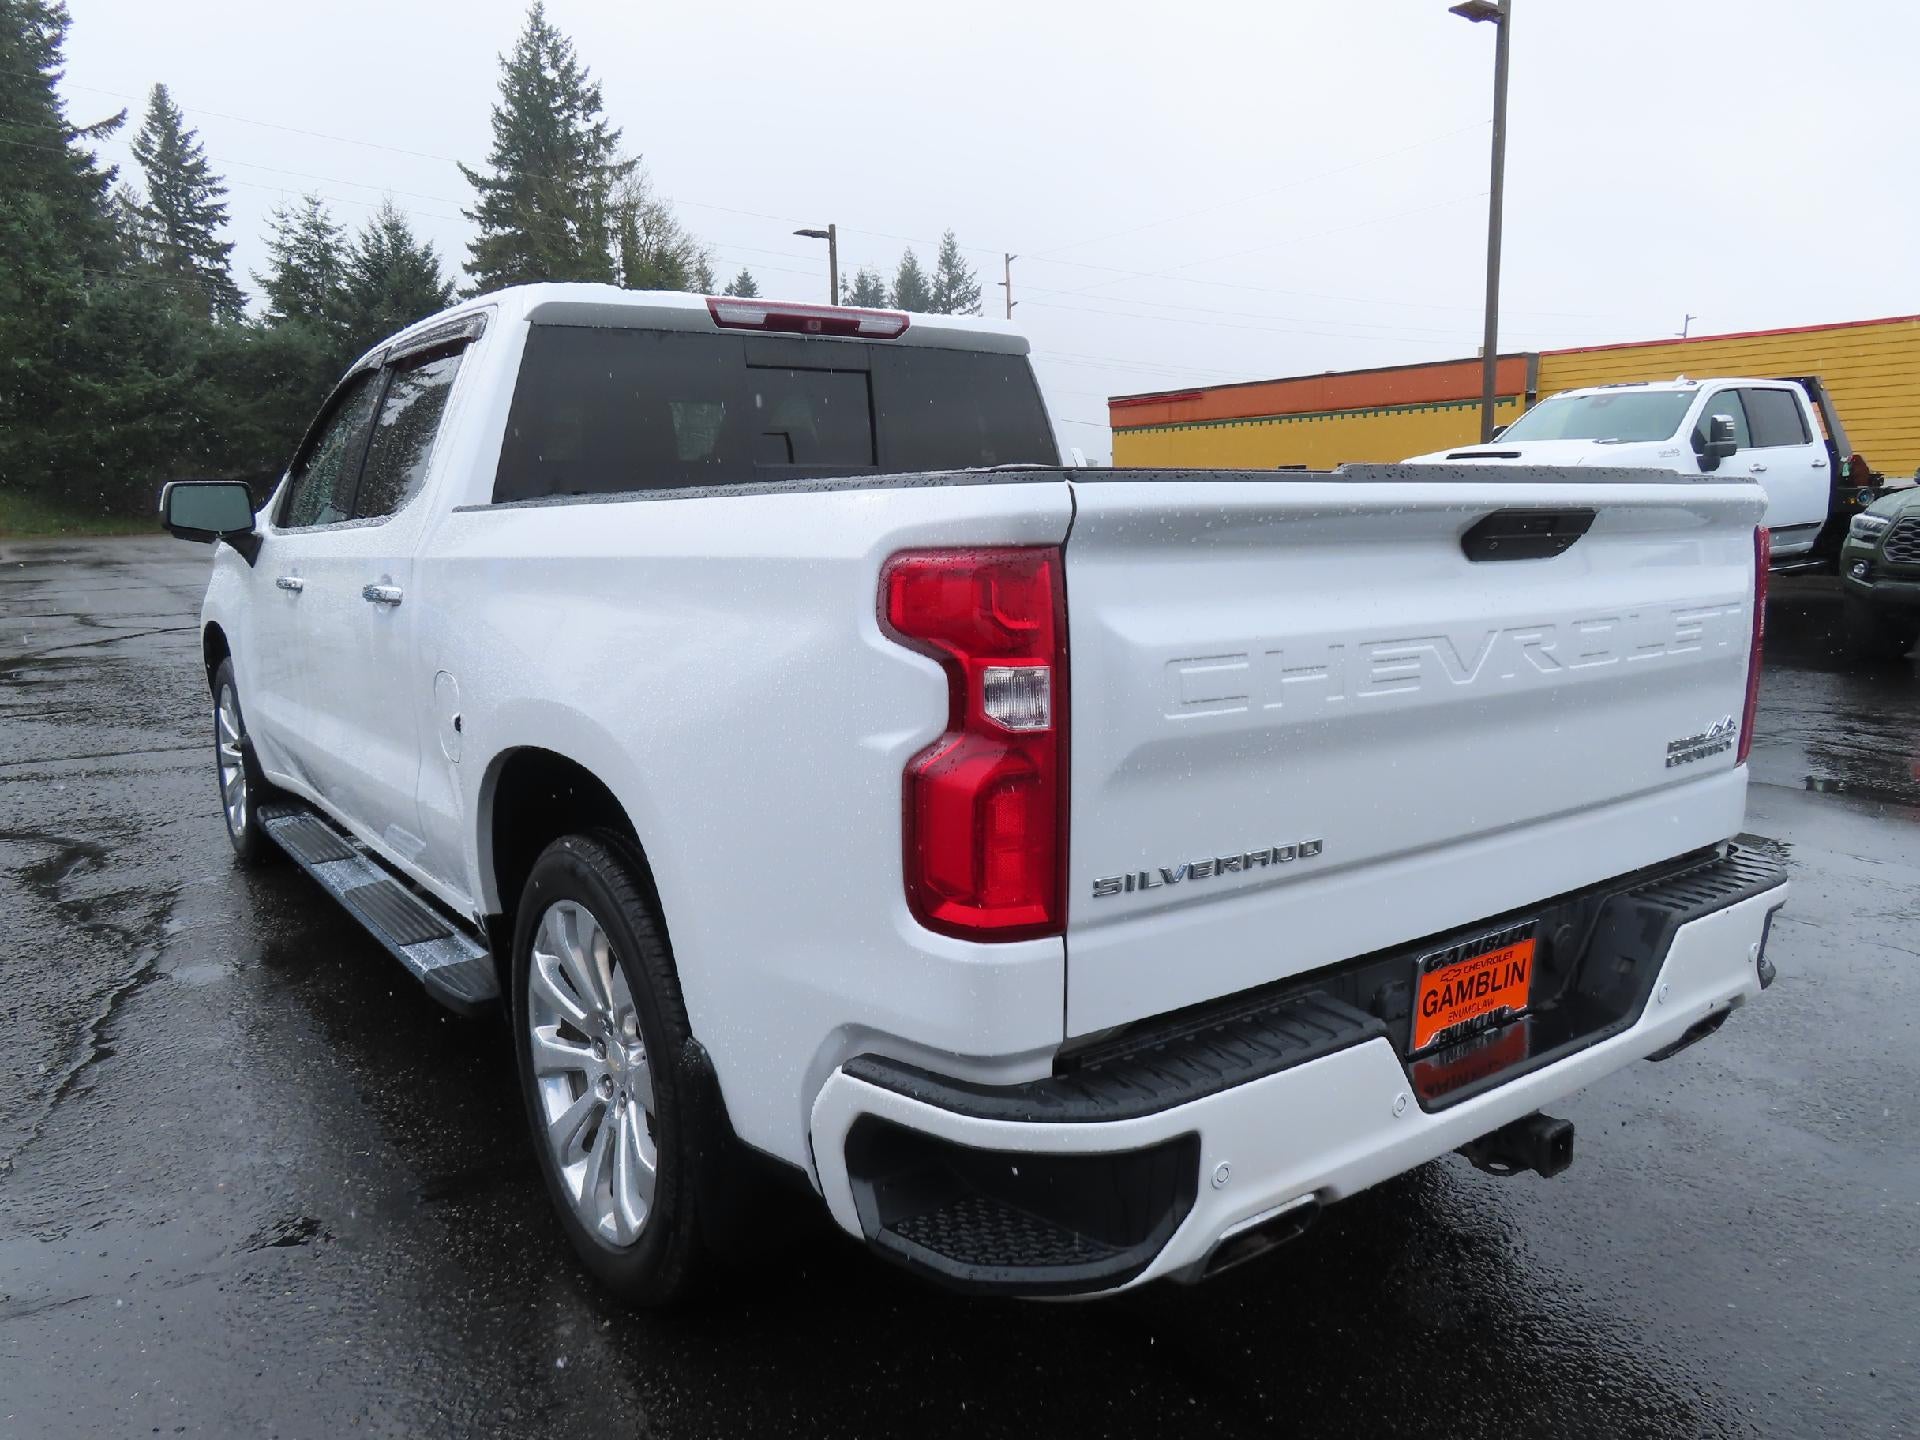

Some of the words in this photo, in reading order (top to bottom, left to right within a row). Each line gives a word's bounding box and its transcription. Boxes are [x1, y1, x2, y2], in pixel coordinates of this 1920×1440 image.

[1164, 602, 1742, 720] CHEVROLET
[1092, 838, 1323, 898] SILVERADO
[1422, 958, 1527, 1018] GAMBLIN
[1463, 950, 1515, 974] CHEVROLET
